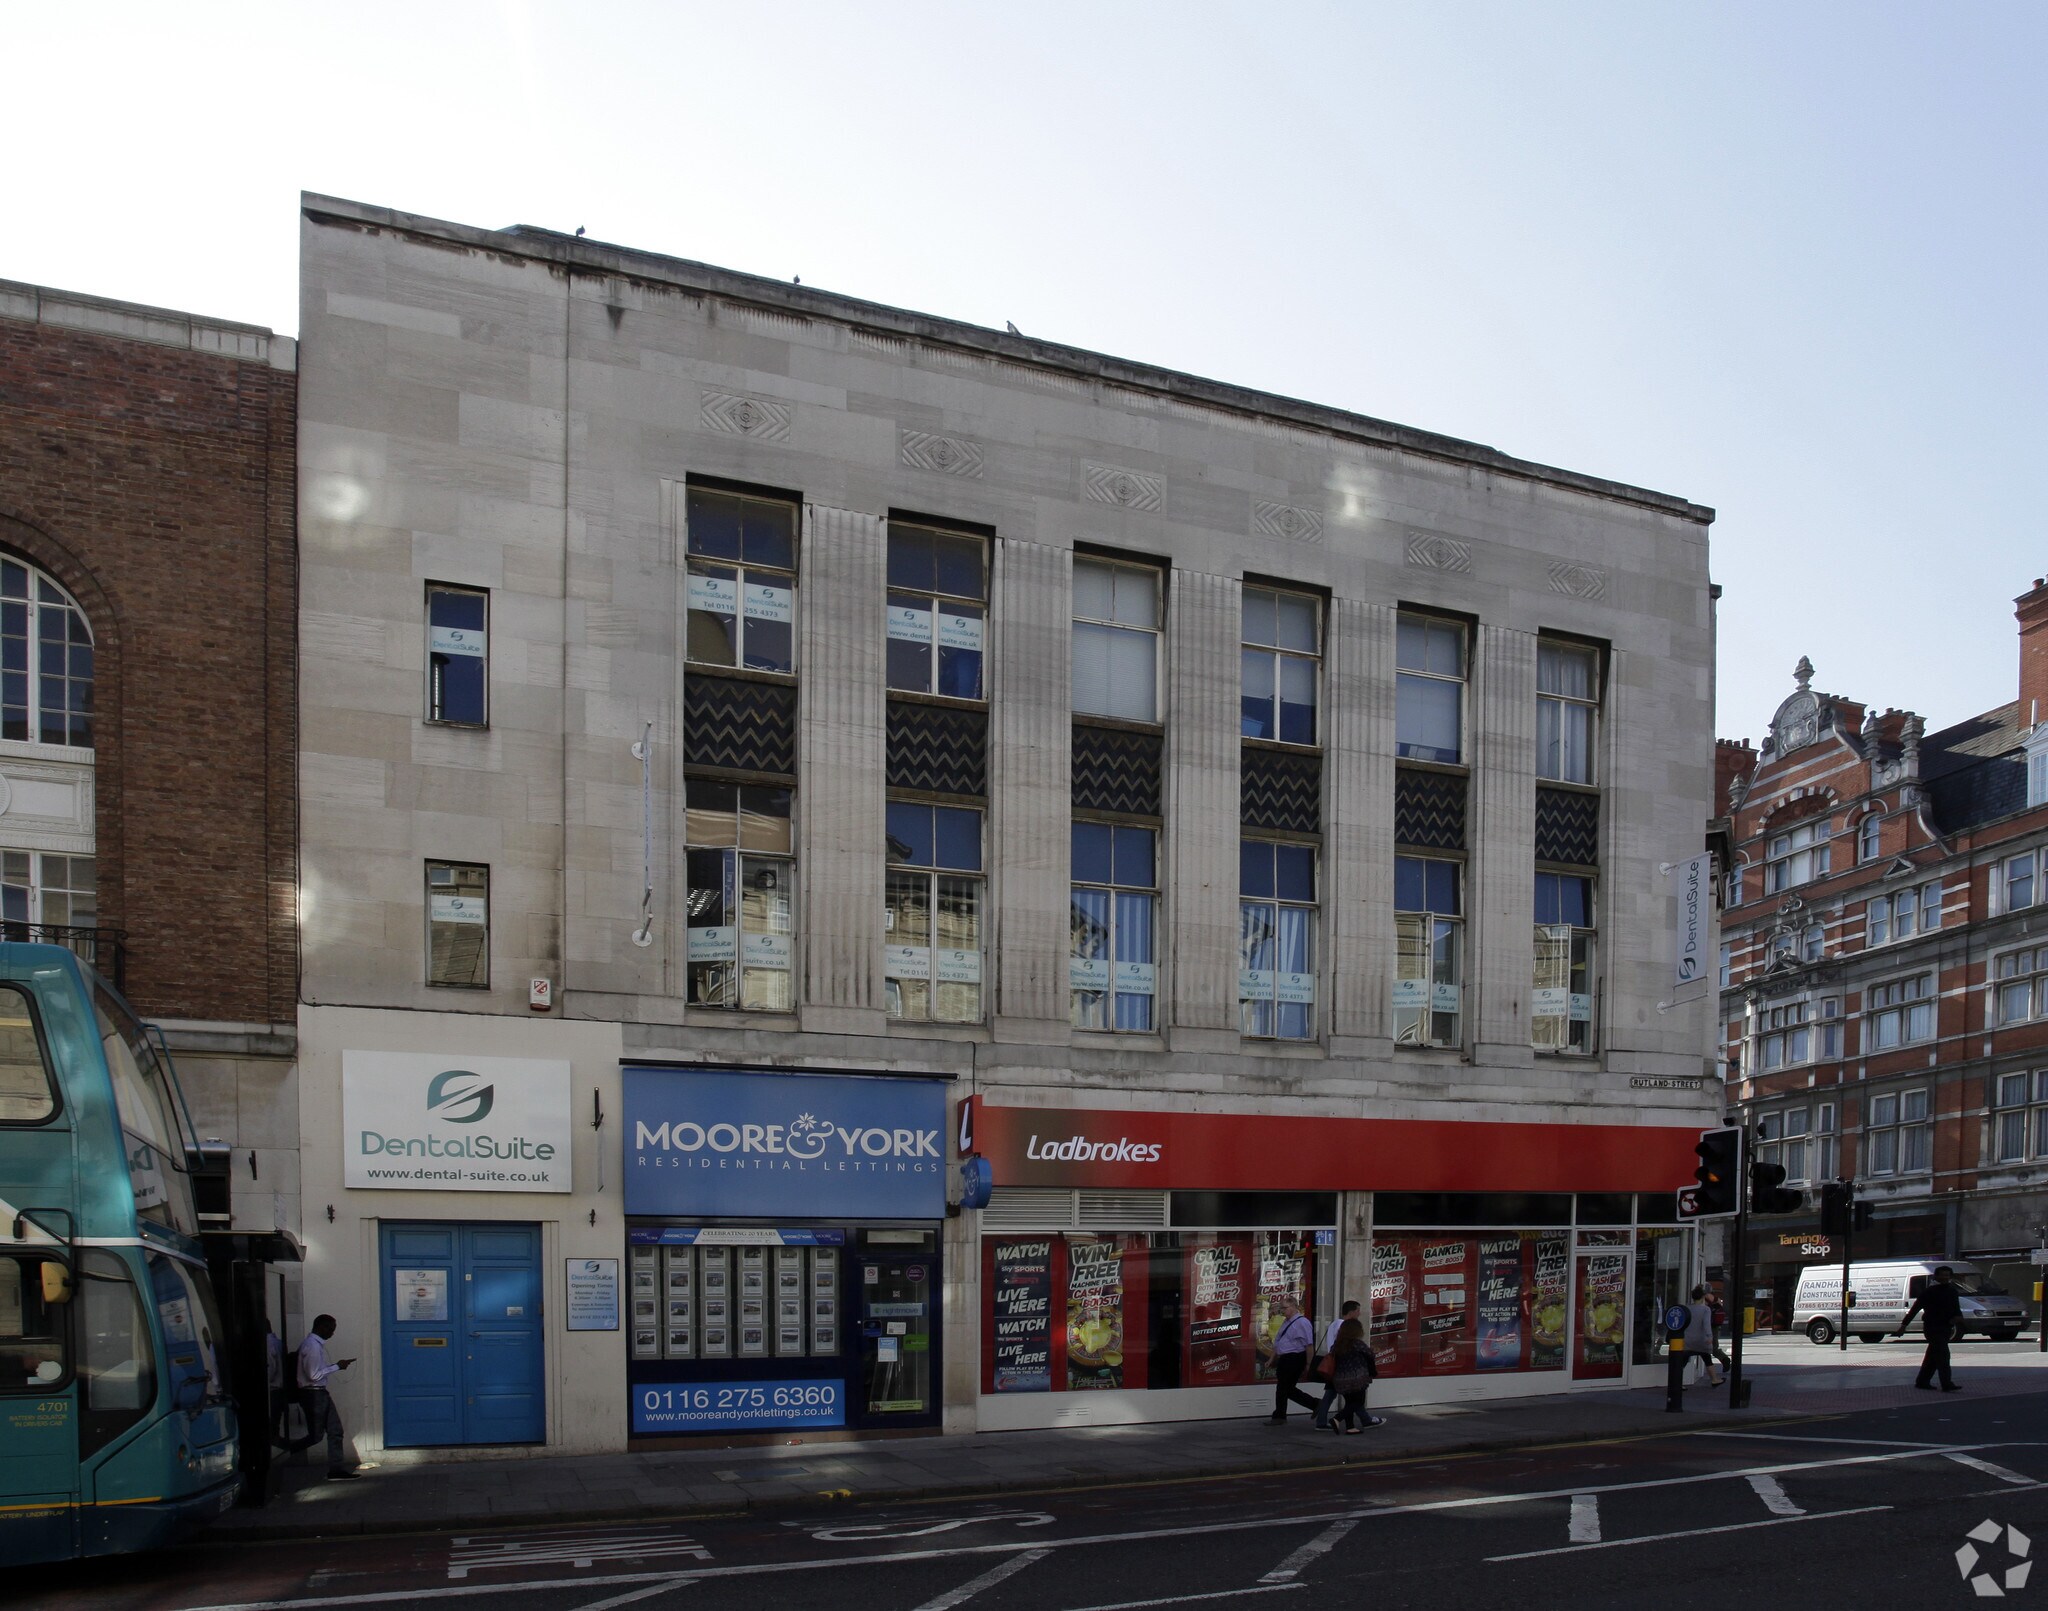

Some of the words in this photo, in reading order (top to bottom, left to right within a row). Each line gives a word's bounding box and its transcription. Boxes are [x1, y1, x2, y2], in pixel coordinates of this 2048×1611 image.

[717, 602, 735, 611] 0116
[745, 607, 758, 615] 255
[761, 609, 778, 618] 4373
[1684, 861, 1700, 954] DentalSuite
[1633, 1079, 1668, 1087] RUTLAND
[1671, 1080, 1699, 1088] STREET
[959, 1101, 972, 1152] L
[636, 1121, 784, 1153] MOORE
[786, 1112, 834, 1159] &
[836, 1127, 940, 1157] YORK
[361, 1130, 556, 1162] DentalSuite
[1026, 1134, 1163, 1163] Ladbrokes
[638, 1156, 806, 1171] RESIDENTIAL
[824, 1161, 938, 1173] LETTINGS
[367, 1167, 550, 1183] www.dental-suite.co.uk
[1778, 1232, 1821, 1246] Tanning
[996, 1242, 1050, 1261] WATCH
[1072, 1242, 1114, 1265] WIN
[1424, 1243, 1465, 1259] BANKER
[1480, 1239, 1521, 1255] WATCH
[1537, 1240, 1566, 1258] WIN
[1801, 1243, 1831, 1257] Shop
[1195, 1246, 1234, 1264] GOAL
[1425, 1259, 1443, 1267] PRICE
[1445, 1256, 1464, 1265] BOOST
[1493, 1258, 1518, 1266] SPORTS
[1014, 1264, 1046, 1273] SPORTS
[1073, 1259, 1120, 1281] FREE
[1202, 1260, 1239, 1278] RUSH
[1372, 1258, 1405, 1274] RUSH
[1591, 1255, 1623, 1271] FREE
[1071, 1280, 1100, 1289] MACHINE
[1101, 1277, 1119, 1286] PLAY
[1215, 1281, 1237, 1289] TEAMS
[1480, 1277, 1505, 1292] LIVE
[1537, 1278, 1558, 1288] CASH
[1590, 1276, 1610, 1286] CASH
[1596, 1282, 1623, 1294] BOOST!
[997, 1286, 1029, 1303] LIVE
[1073, 1287, 1102, 1299] CASH
[1195, 1287, 1239, 1304] SCORE?
[1262, 1284, 1287, 1297] CASH
[1371, 1283, 1406, 1298] CORE?
[1488, 1286, 1519, 1301] HERE
[1802, 1291, 1844, 1299] CONSTRUCTI
[1008, 1297, 1048, 1314] HERE
[1082, 1294, 1120, 1309] BOOST!
[999, 1317, 1047, 1335] WATCH
[1193, 1327, 1217, 1337] HOTTEST
[1217, 1323, 1240, 1333] COUPON
[1386, 1318, 1406, 1327] COUPON
[998, 1344, 1024, 1357] LIVE
[1015, 1351, 1047, 1365] HERE
[644, 1389, 709, 1411] 0116
[717, 1388, 765, 1408] 275
[773, 1386, 835, 1406] 6360
[37, 1402, 68, 1412] 4701
[645, 1405, 834, 1422] www.mooreandyorklettings.co.uk
[9, 1414, 36, 1422] BATTERY
